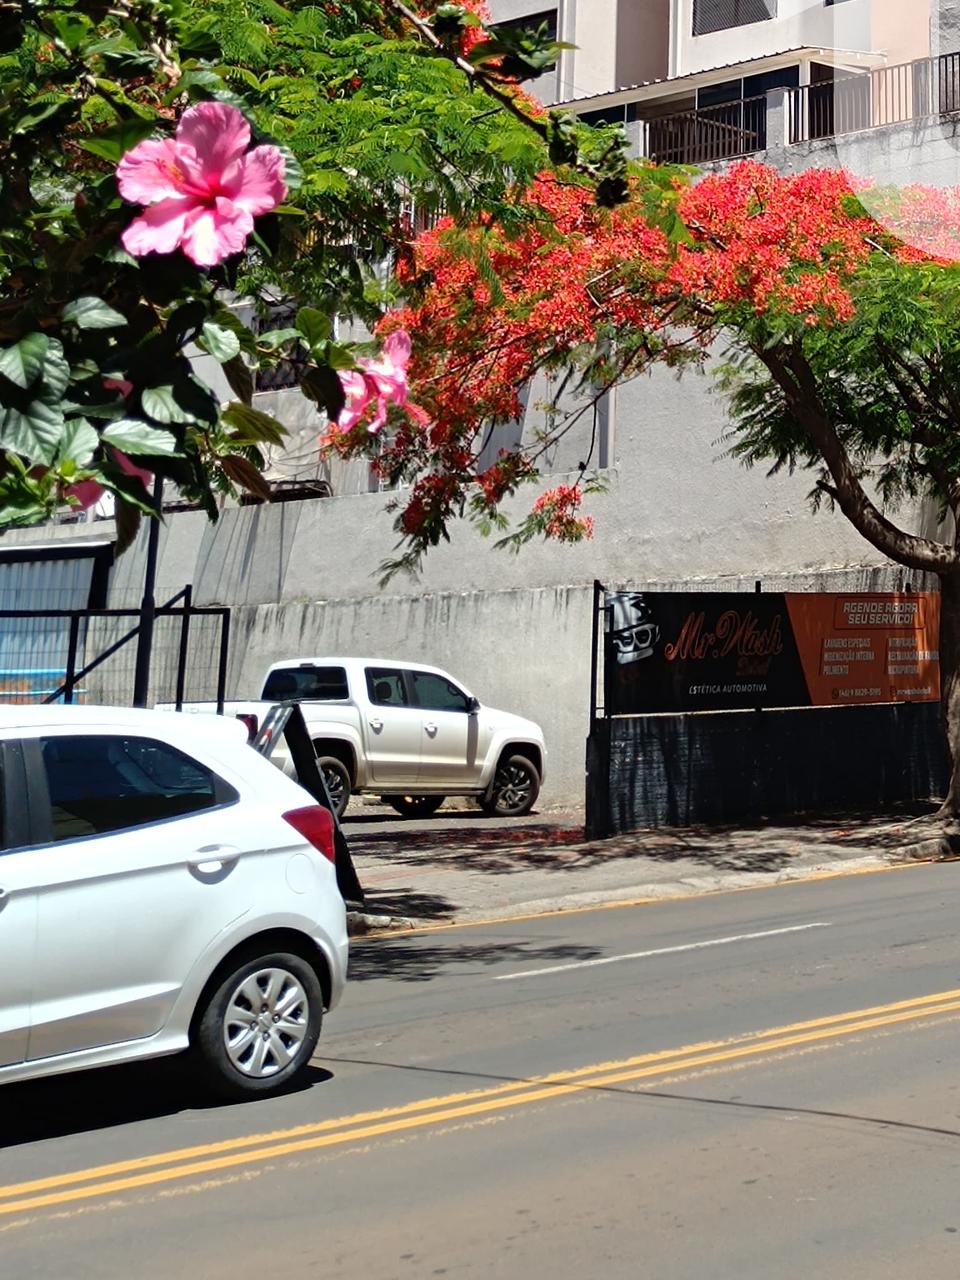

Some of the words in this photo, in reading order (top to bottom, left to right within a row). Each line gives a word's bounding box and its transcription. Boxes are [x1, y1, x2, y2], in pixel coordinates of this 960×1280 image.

[843, 602, 885, 613] AGENDE
[885, 602, 918, 613] AGORA
[848, 613, 868, 624] SEU
[689, 683, 721, 695] ESTÉTICA
[722, 683, 767, 693] AUTOMOTIVA
